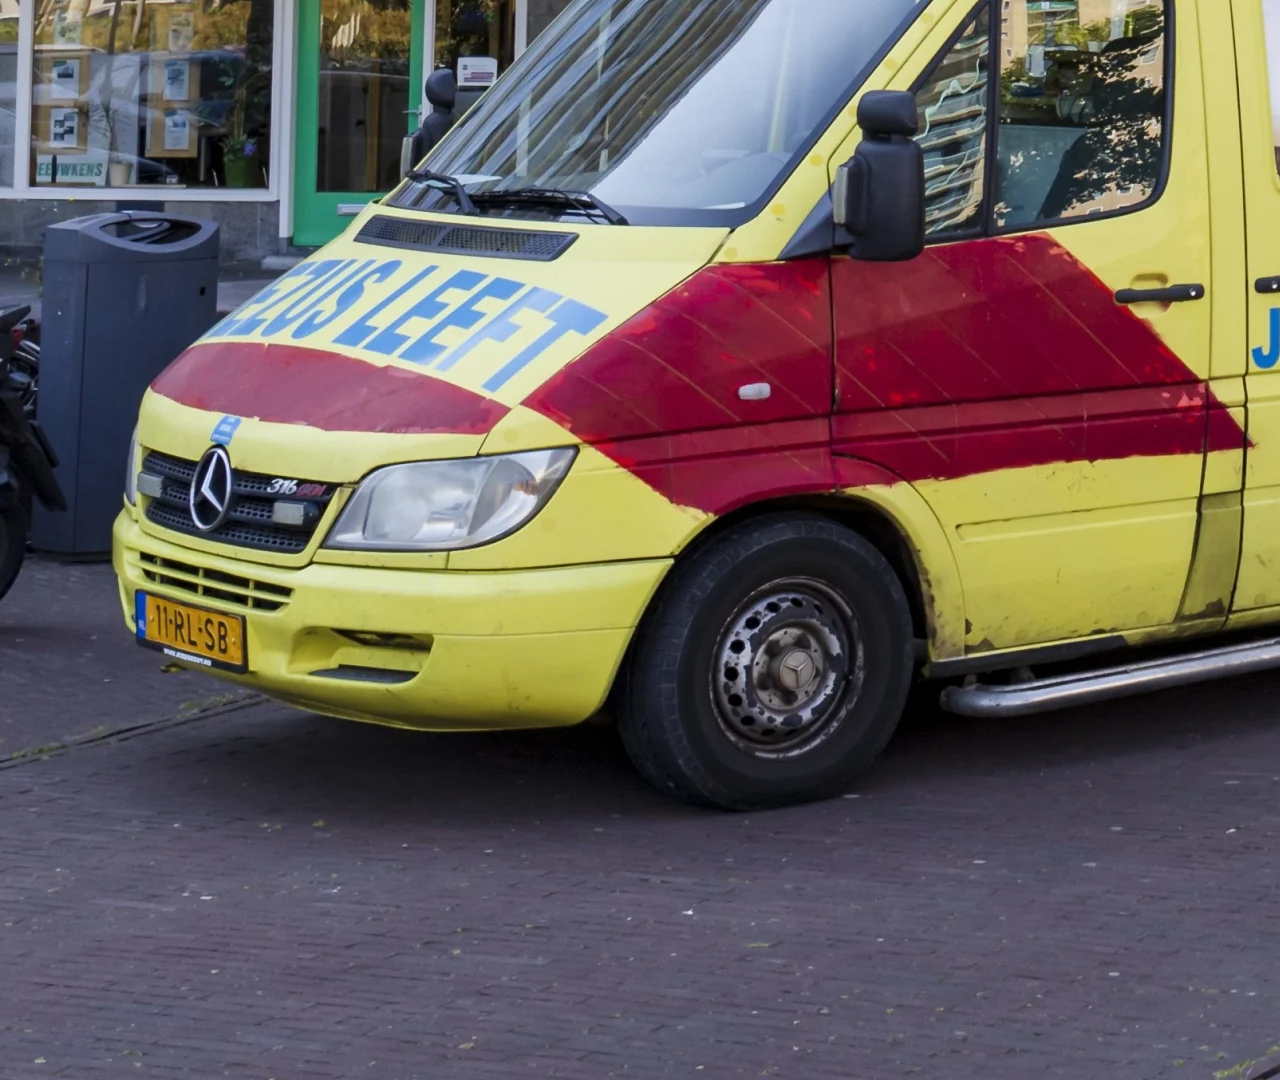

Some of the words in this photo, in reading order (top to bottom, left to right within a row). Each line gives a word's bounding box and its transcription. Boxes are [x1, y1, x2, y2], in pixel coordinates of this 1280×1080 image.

[207, 259, 402, 339] EZUS
[331, 264, 610, 393] LEEFT
[155, 604, 228, 655] 11-RL-SB
